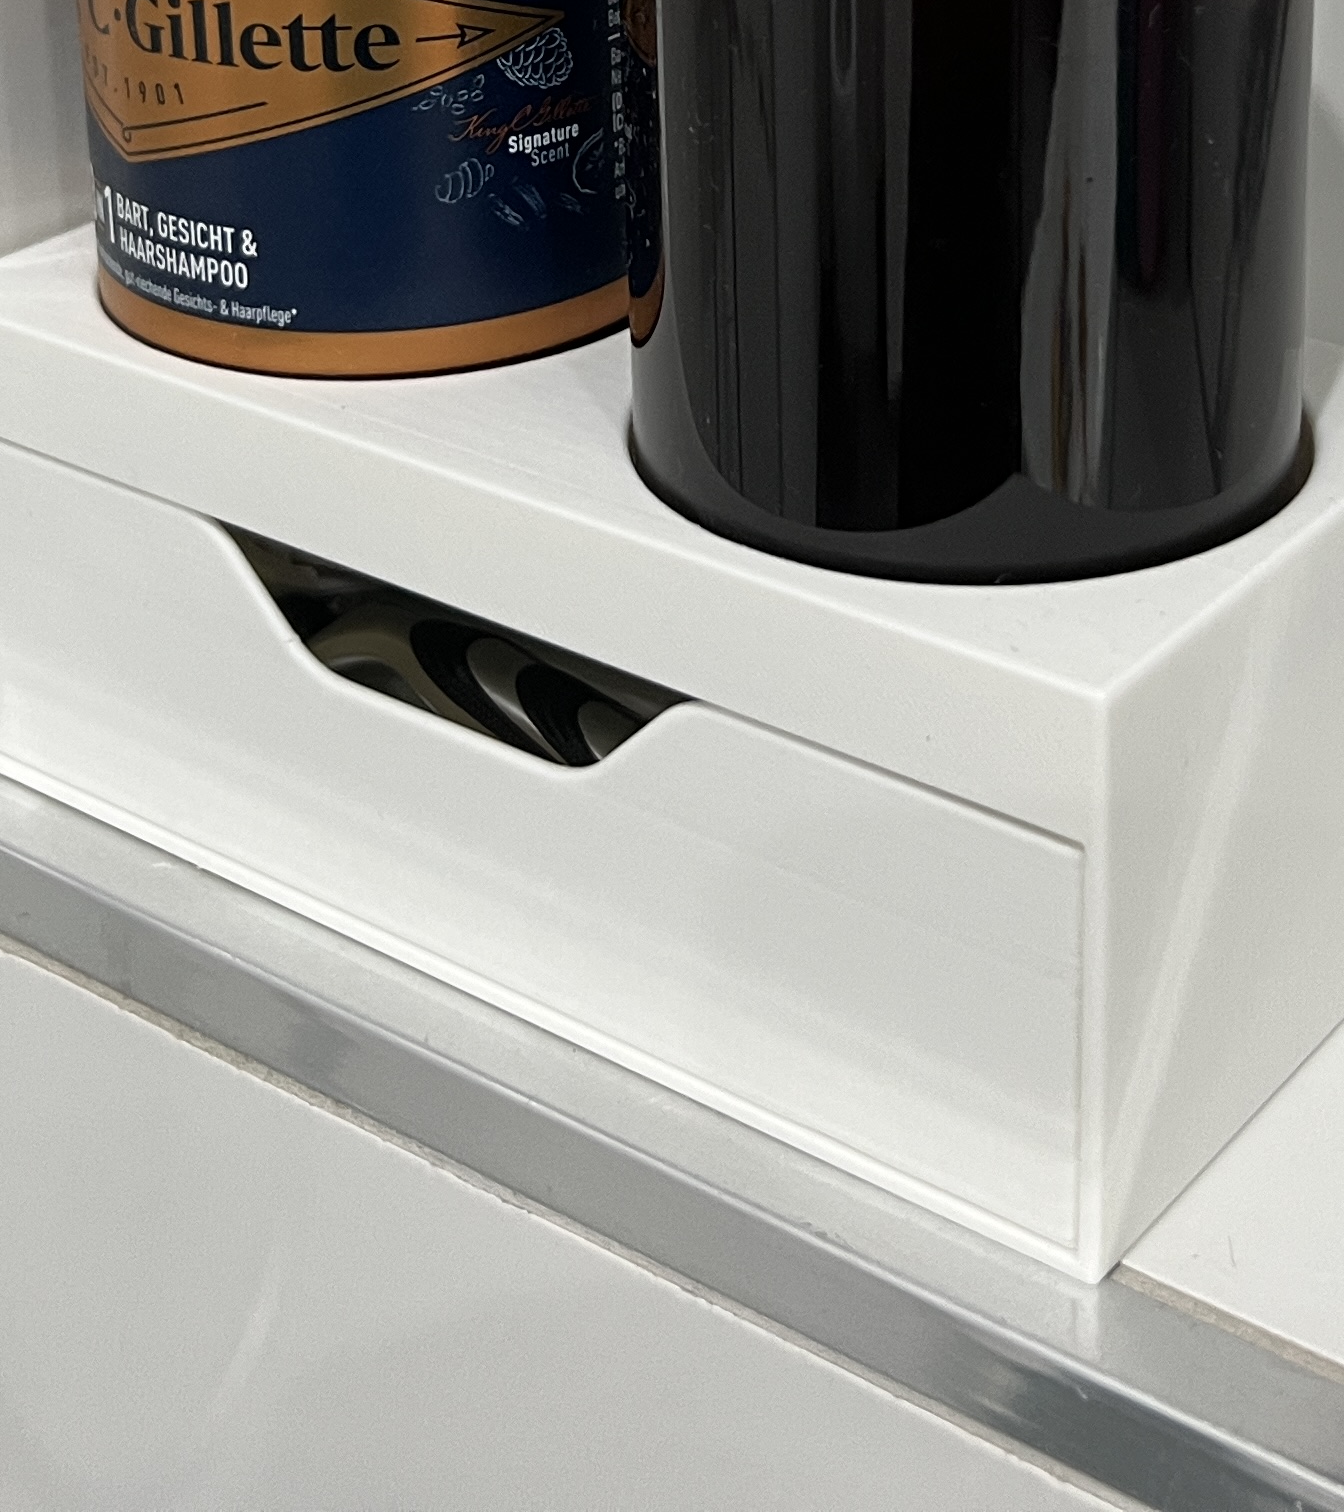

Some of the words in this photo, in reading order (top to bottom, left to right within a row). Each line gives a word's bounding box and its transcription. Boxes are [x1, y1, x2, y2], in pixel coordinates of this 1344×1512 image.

[508, 123, 580, 154] Signature
[530, 142, 570, 167] Scent
[116, 192, 154, 237] BART,
[157, 211, 235, 254] GESICHT
[241, 229, 258, 257] &
[119, 225, 248, 289] HAARSHAMPOO
[173, 288, 218, 312] Gesichts-
[219, 299, 229, 316] &
